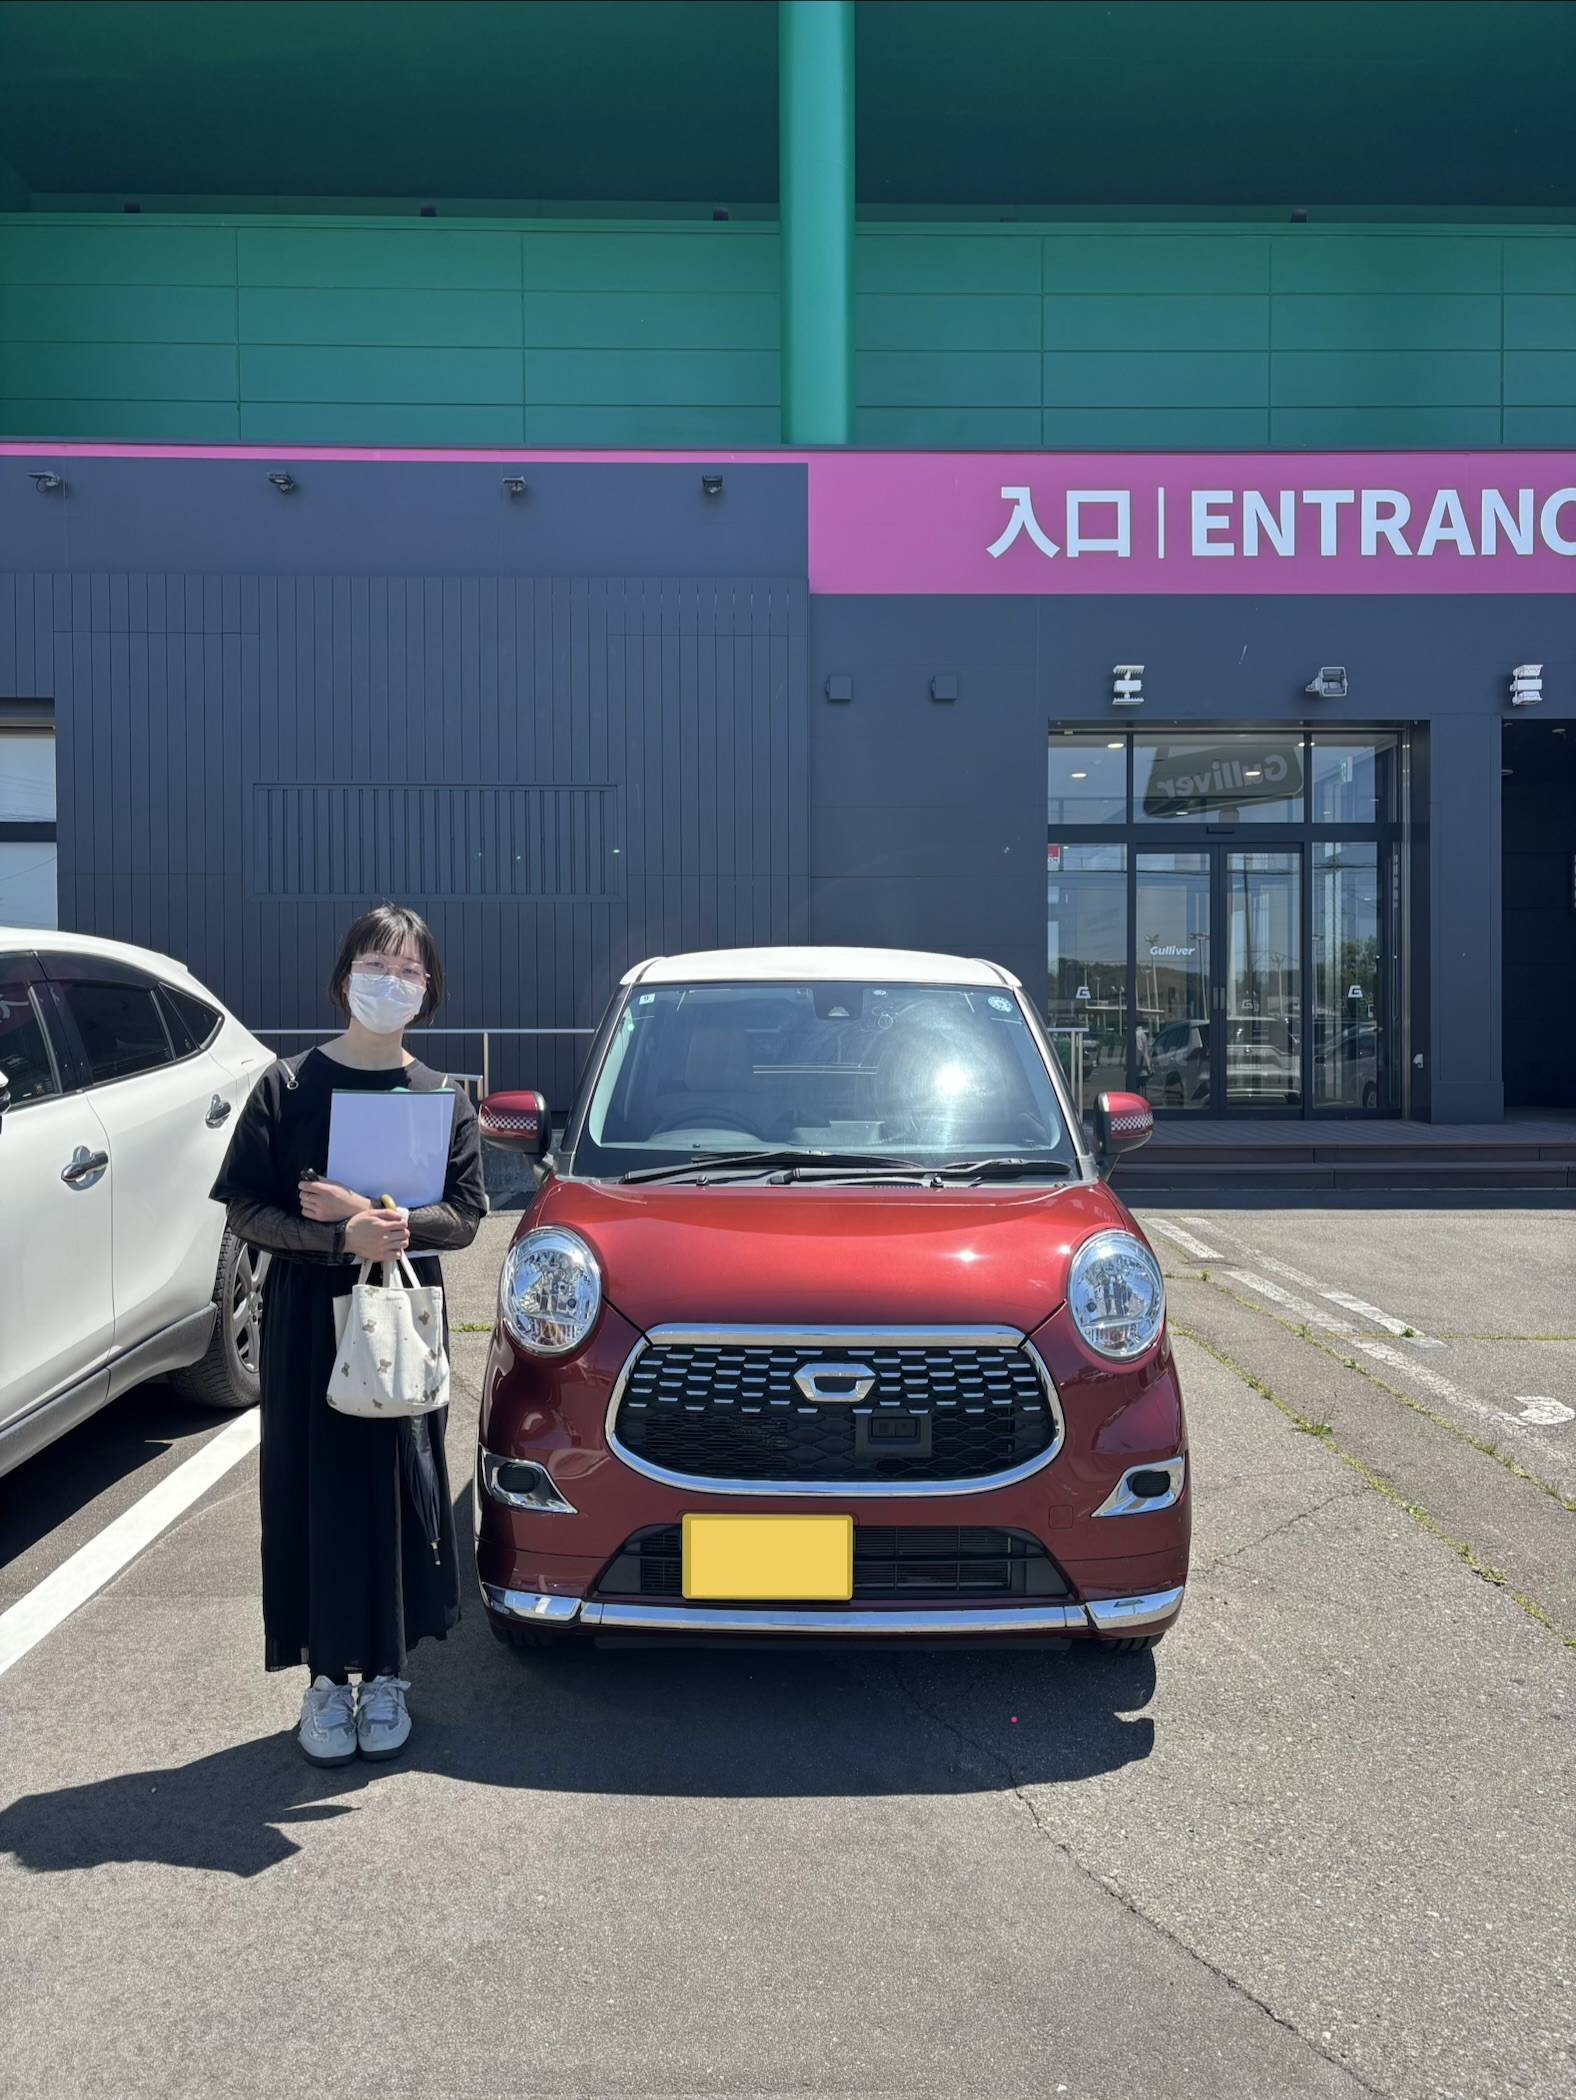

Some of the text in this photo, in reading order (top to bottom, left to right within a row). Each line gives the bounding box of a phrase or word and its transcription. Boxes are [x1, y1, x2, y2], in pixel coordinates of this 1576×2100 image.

[985, 486, 1576, 559] 入口 ENTRANC
[1150, 945, 1196, 956] Gulliver
